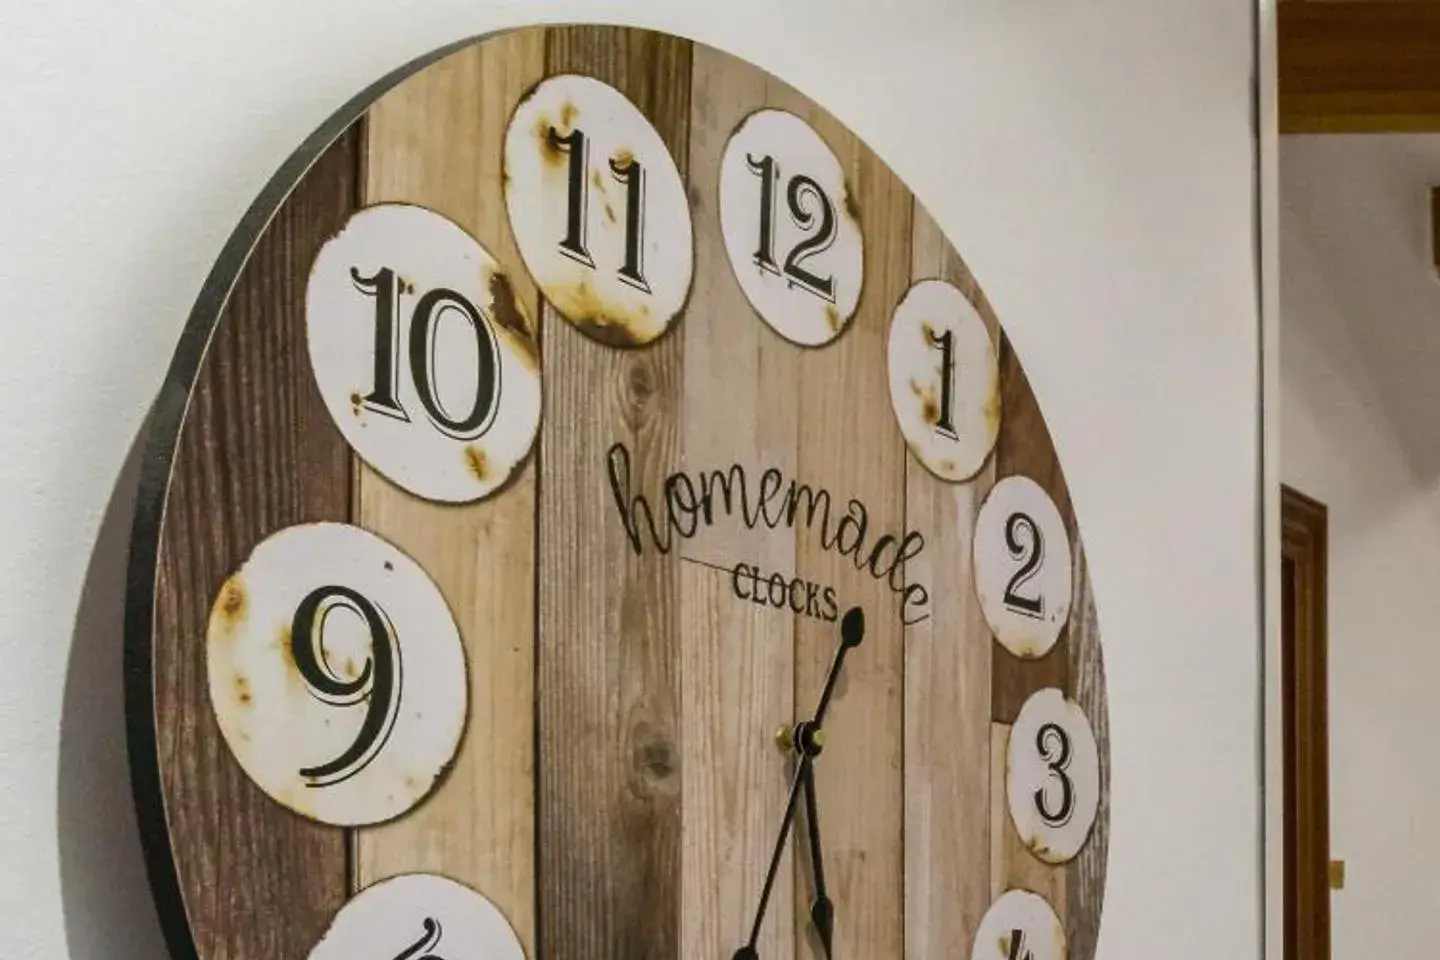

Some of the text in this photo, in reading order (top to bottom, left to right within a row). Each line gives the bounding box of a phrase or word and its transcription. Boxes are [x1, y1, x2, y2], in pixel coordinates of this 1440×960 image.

[550, 125, 652, 295] 11
[745, 152, 836, 304] 12
[350, 266, 501, 441] 10
[929, 329, 959, 442] 1
[607, 442, 930, 625] homemade
[732, 562, 838, 622] CLOCKS
[1003, 512, 1047, 620] 2
[291, 585, 402, 788] 9
[1034, 722, 1077, 829] 3
